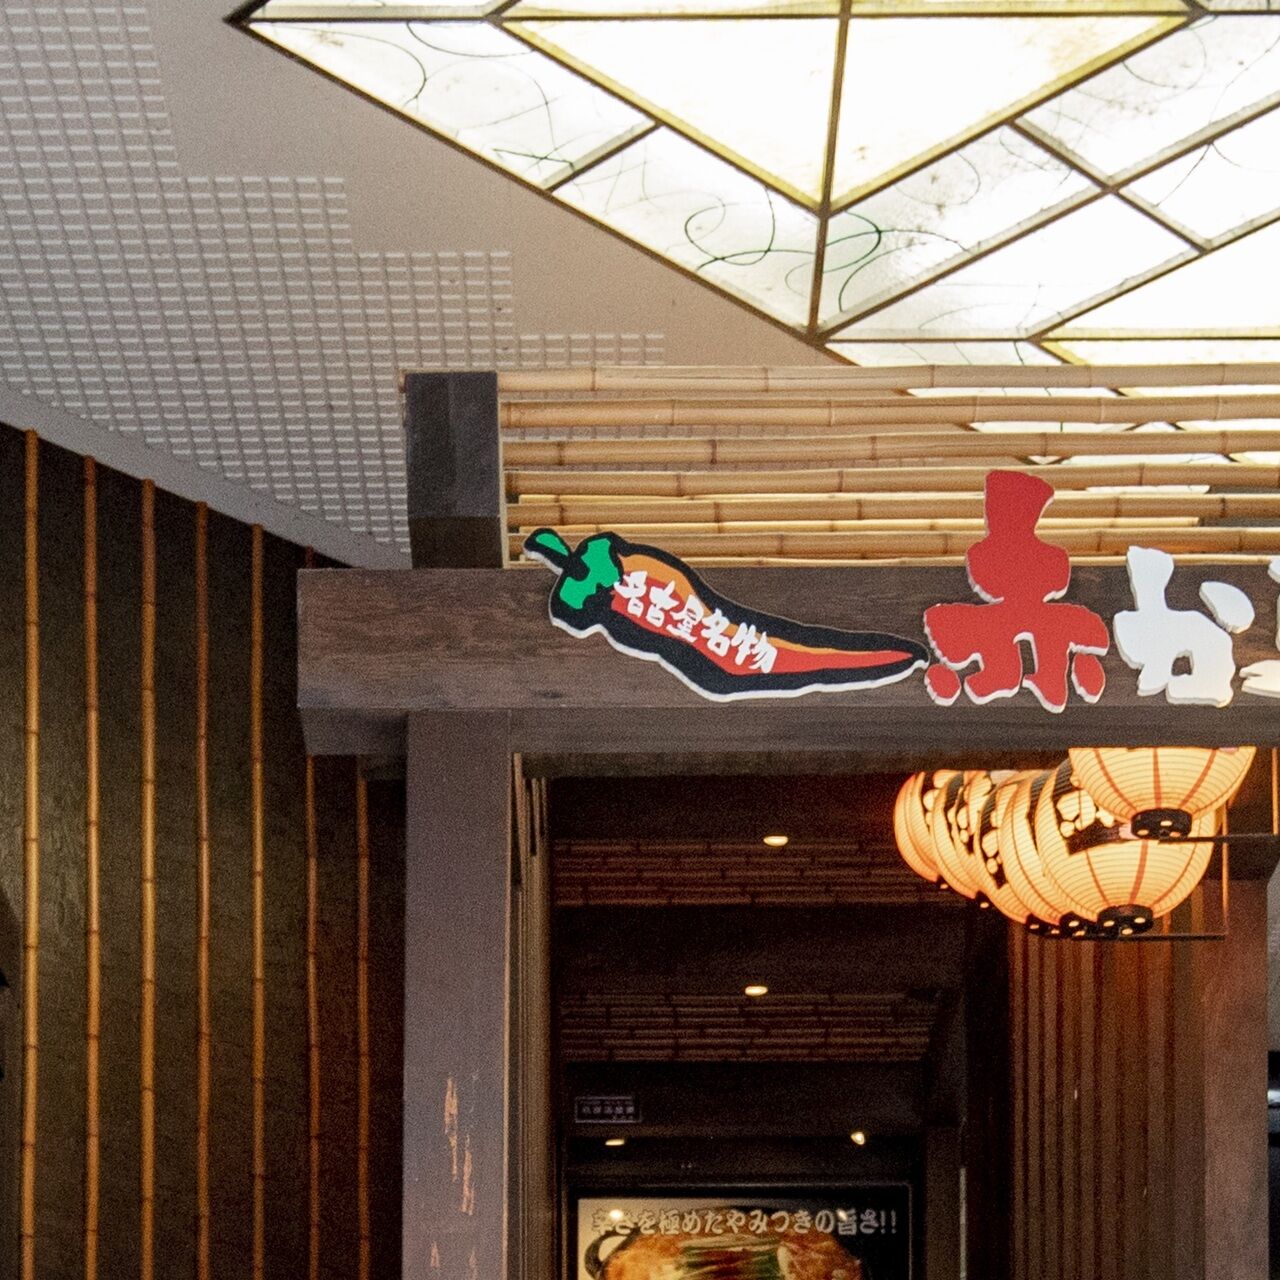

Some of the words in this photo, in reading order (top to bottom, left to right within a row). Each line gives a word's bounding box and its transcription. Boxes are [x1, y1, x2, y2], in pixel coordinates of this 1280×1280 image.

[616, 569, 778, 674] 名古屋名物
